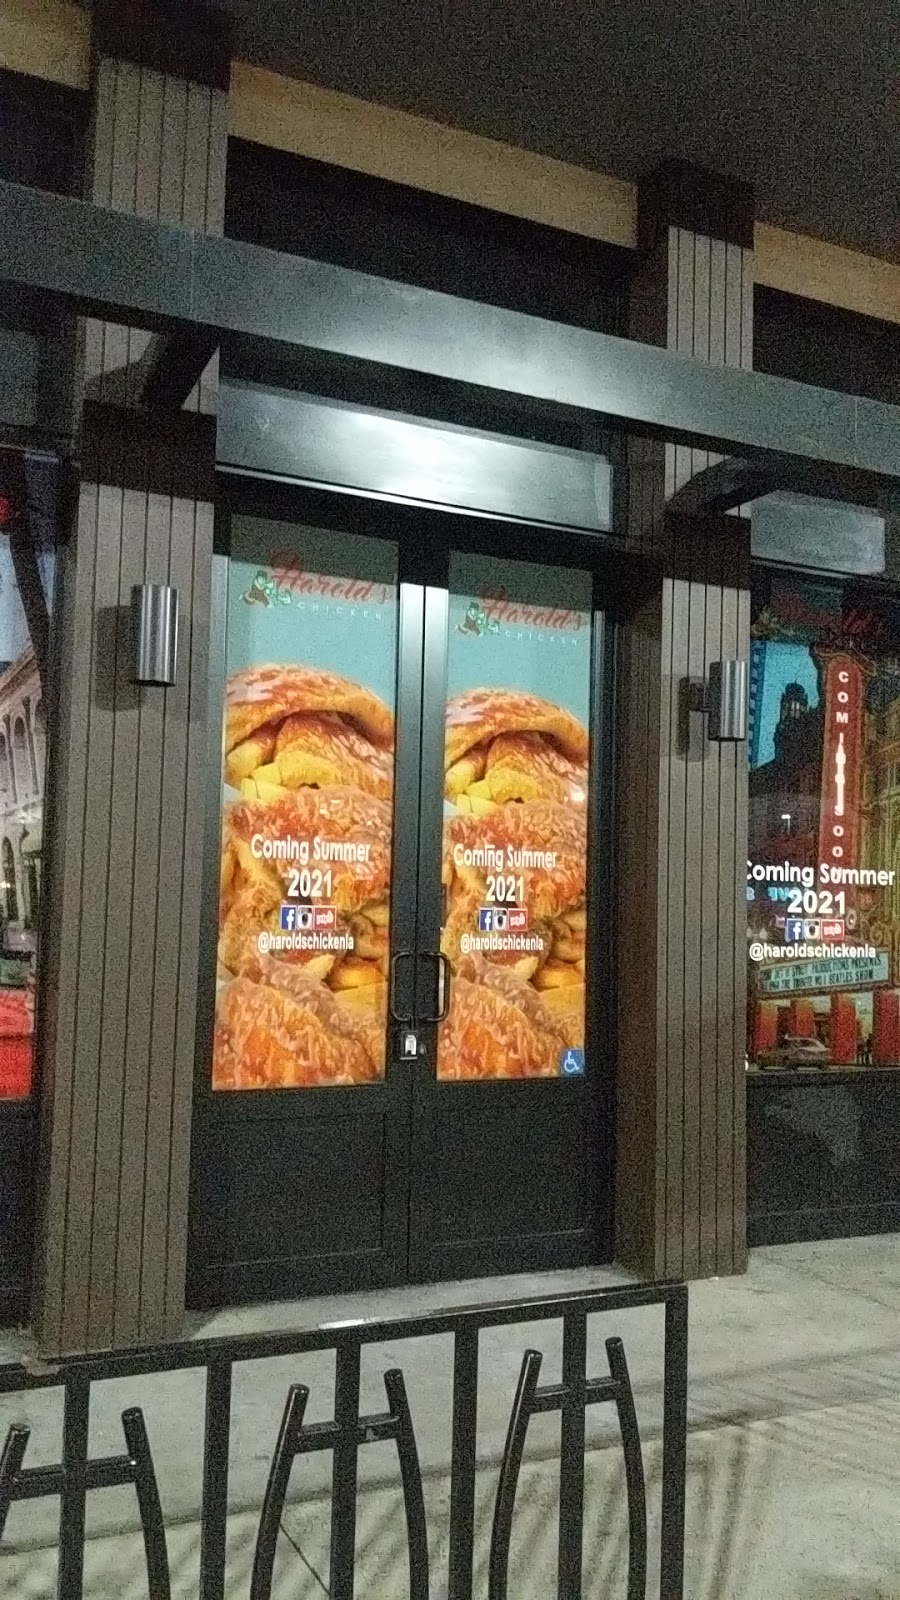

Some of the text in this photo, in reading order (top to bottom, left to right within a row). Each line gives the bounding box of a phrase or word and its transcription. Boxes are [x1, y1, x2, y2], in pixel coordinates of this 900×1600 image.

[270, 552, 391, 606] Harold's
[297, 600, 384, 621] CHICKEN
[482, 588, 588, 631] Harold's
[504, 629, 579, 647] CHICKEN
[251, 833, 371, 865] Coming Summer
[453, 843, 558, 872] Coming Summer
[287, 868, 333, 897] 2021
[820, 863, 895, 886] Summer
[486, 875, 524, 902] 2021
[787, 890, 845, 914] 2021
[258, 932, 354, 954] @haroldschickenla
[460, 933, 543, 954] @haroldschickenla
[749, 942, 876, 961] @haroldschickenla
